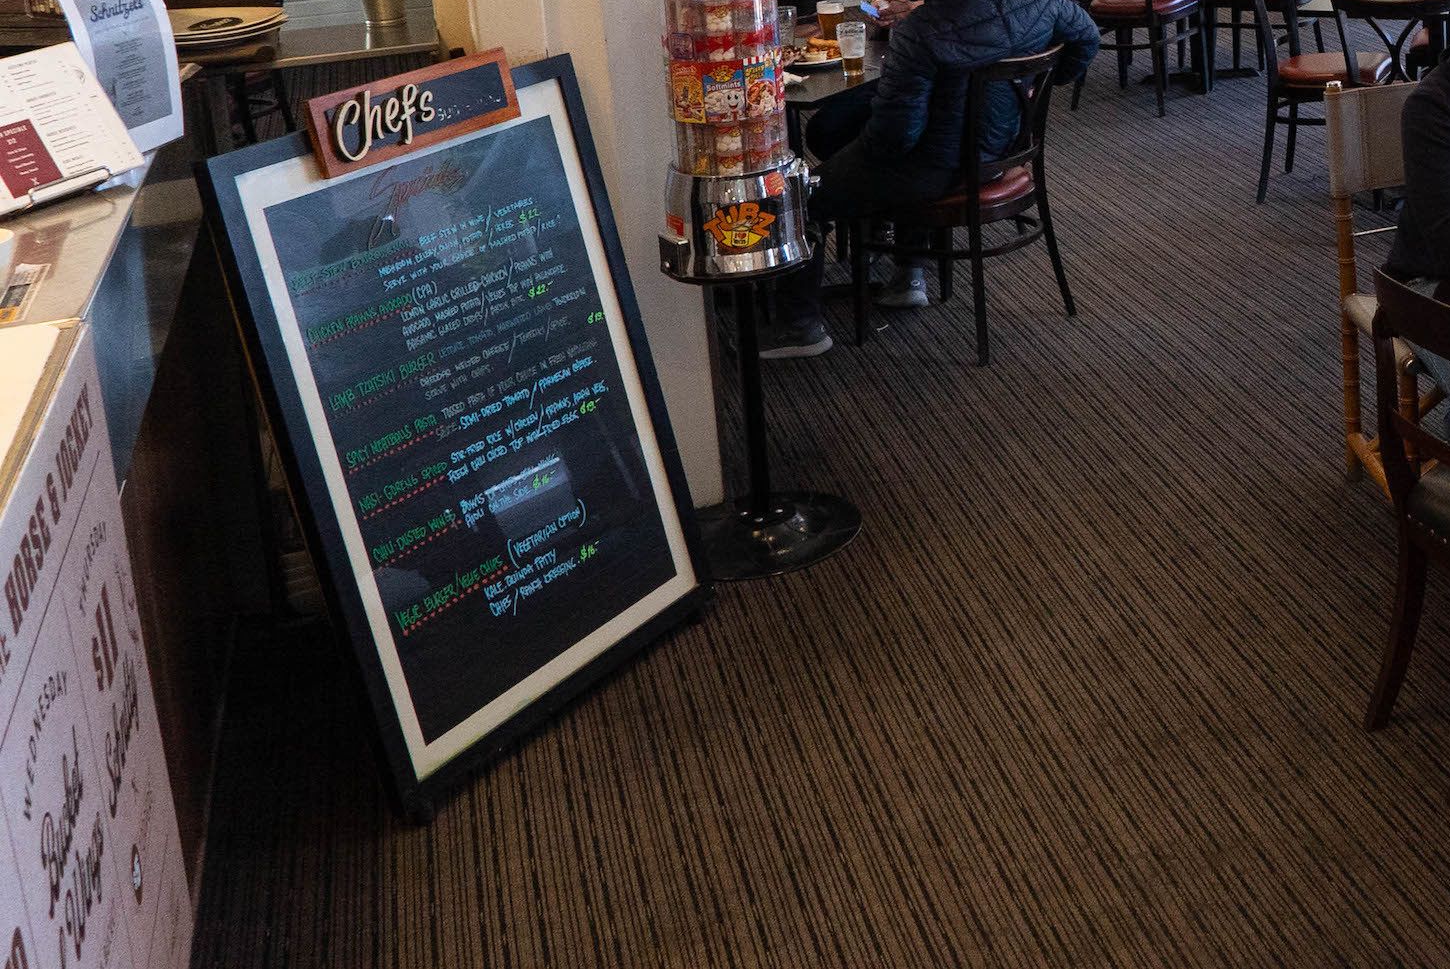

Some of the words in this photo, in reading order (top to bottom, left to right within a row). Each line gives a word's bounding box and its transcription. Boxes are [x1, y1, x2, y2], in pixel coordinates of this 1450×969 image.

[706, 81, 741, 91] Softmints
[335, 83, 436, 162] Chefs
[703, 201, 776, 243] TUBZ
[383, 275, 407, 289] SERVE
[410, 267, 426, 278] WITH
[430, 259, 447, 270] YOUR
[306, 317, 343, 343] CHICKEN
[378, 291, 412, 314] AVOCADO
[400, 303, 425, 321] LEMON
[426, 293, 449, 310] GARLIC
[329, 388, 356, 414] LAMB
[356, 370, 395, 397] TZATSIKI
[399, 352, 436, 378] BURGER
[420, 367, 450, 388] CHEDDAR
[450, 375, 466, 387] WITH
[459, 399, 502, 428] SEMI-DRIED
[503, 387, 529, 407] TOMATO
[538, 367, 570, 390] PARMESAN
[345, 445, 370, 468] SPICY
[370, 426, 411, 455] MEATBALLS
[414, 413, 437, 432] PASTA
[486, 430, 502, 444] RICE
[5, 494, 51, 637] HORSE
[46, 472, 61, 525] &
[56, 382, 93, 503] JOCKEY
[428, 507, 455, 532] WINGS
[79, 520, 106, 618] THURSDAY
[480, 553, 504, 576] CHIPS
[533, 548, 557, 572] PATTY
[92, 583, 119, 693] $11
[23, 670, 67, 822] WEDNESDAY
[105, 652, 140, 819] Schnitty
[41, 725, 84, 920] Bucket
[64, 812, 104, 962] Wings
